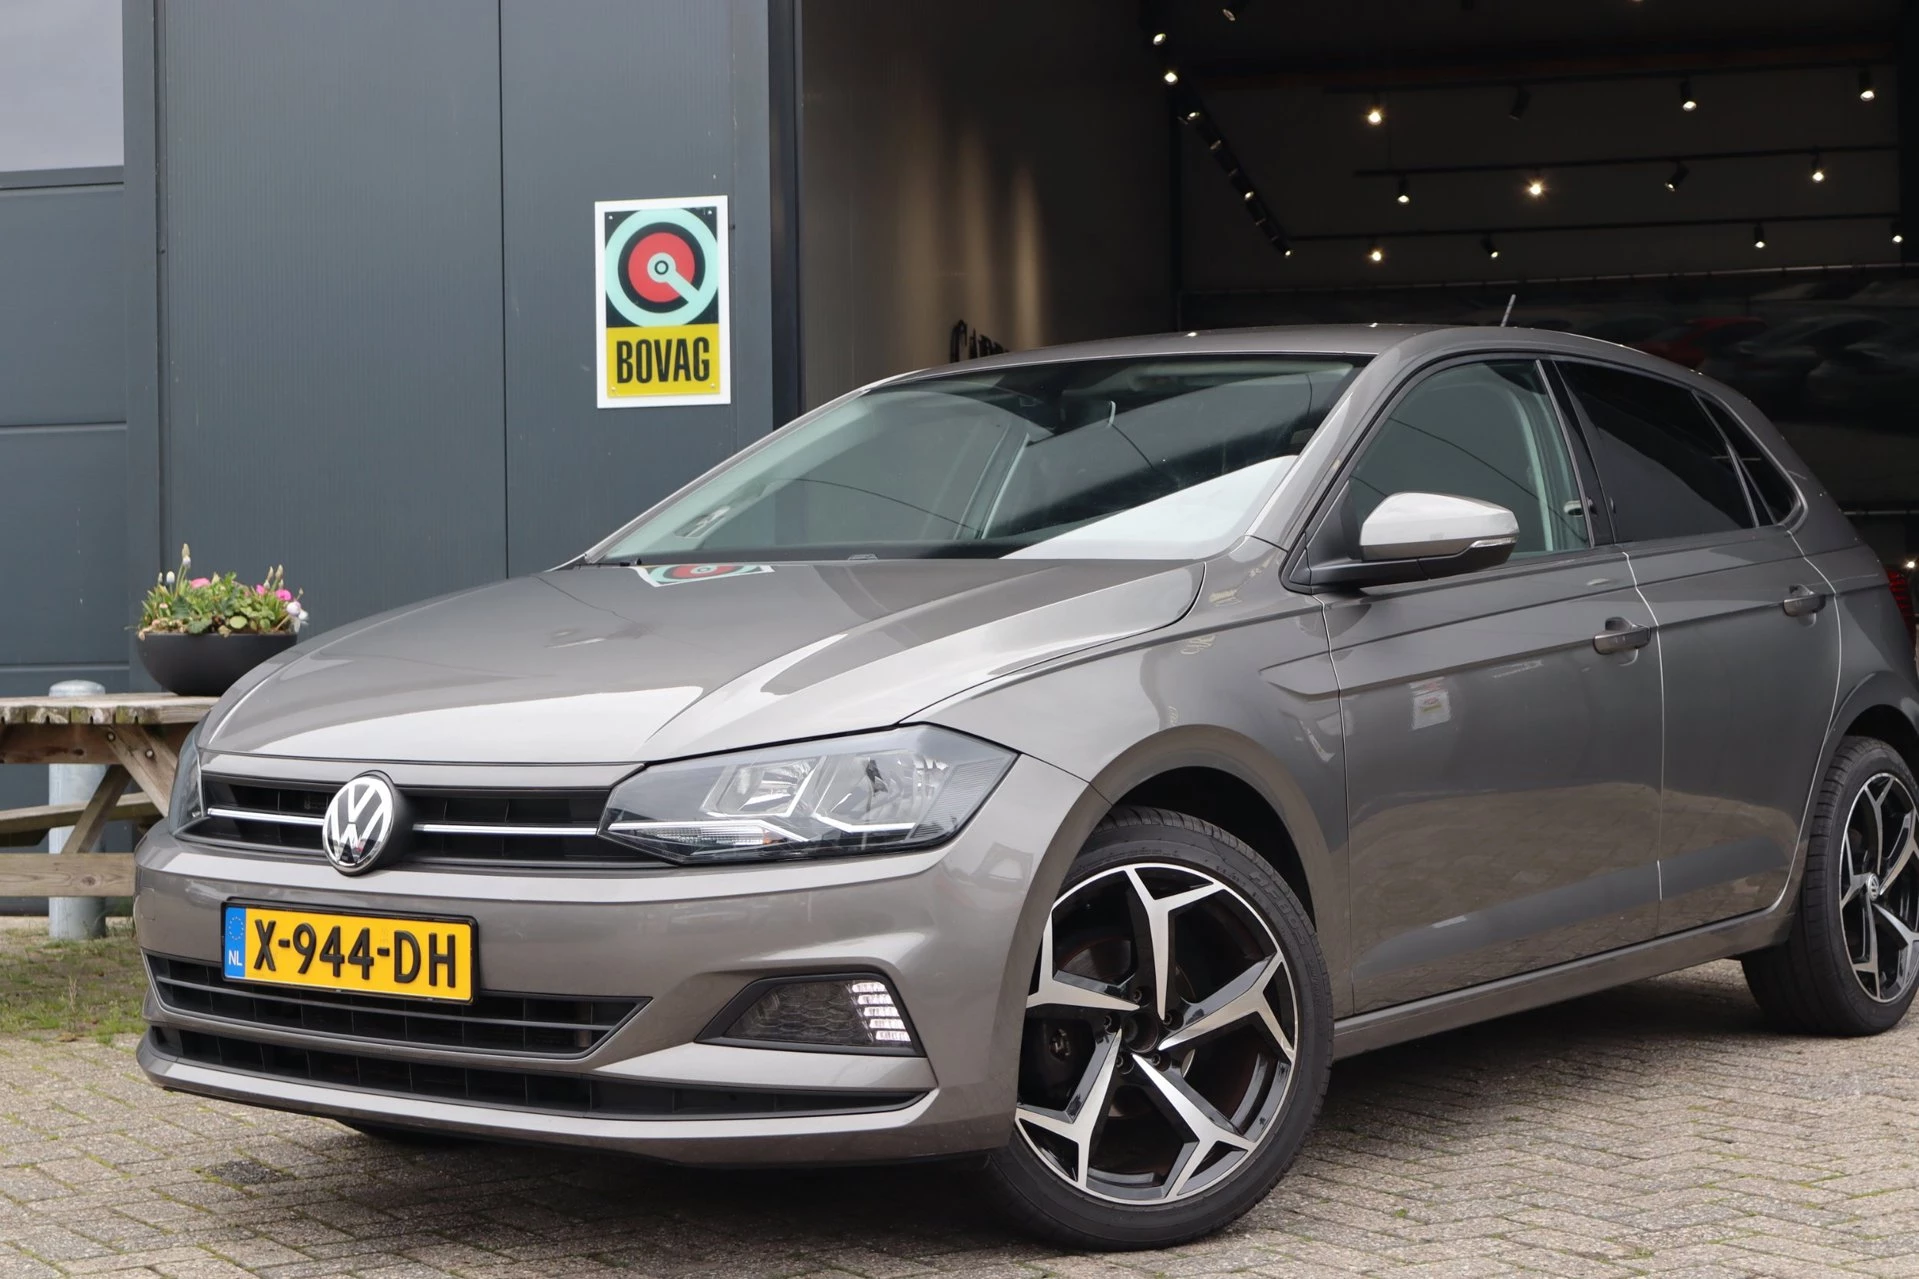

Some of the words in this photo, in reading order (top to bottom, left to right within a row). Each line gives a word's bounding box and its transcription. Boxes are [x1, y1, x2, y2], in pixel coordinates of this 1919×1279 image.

[616, 337, 710, 383] BOVAG
[228, 950, 243, 967] NL
[253, 919, 456, 988] X-944-DH
